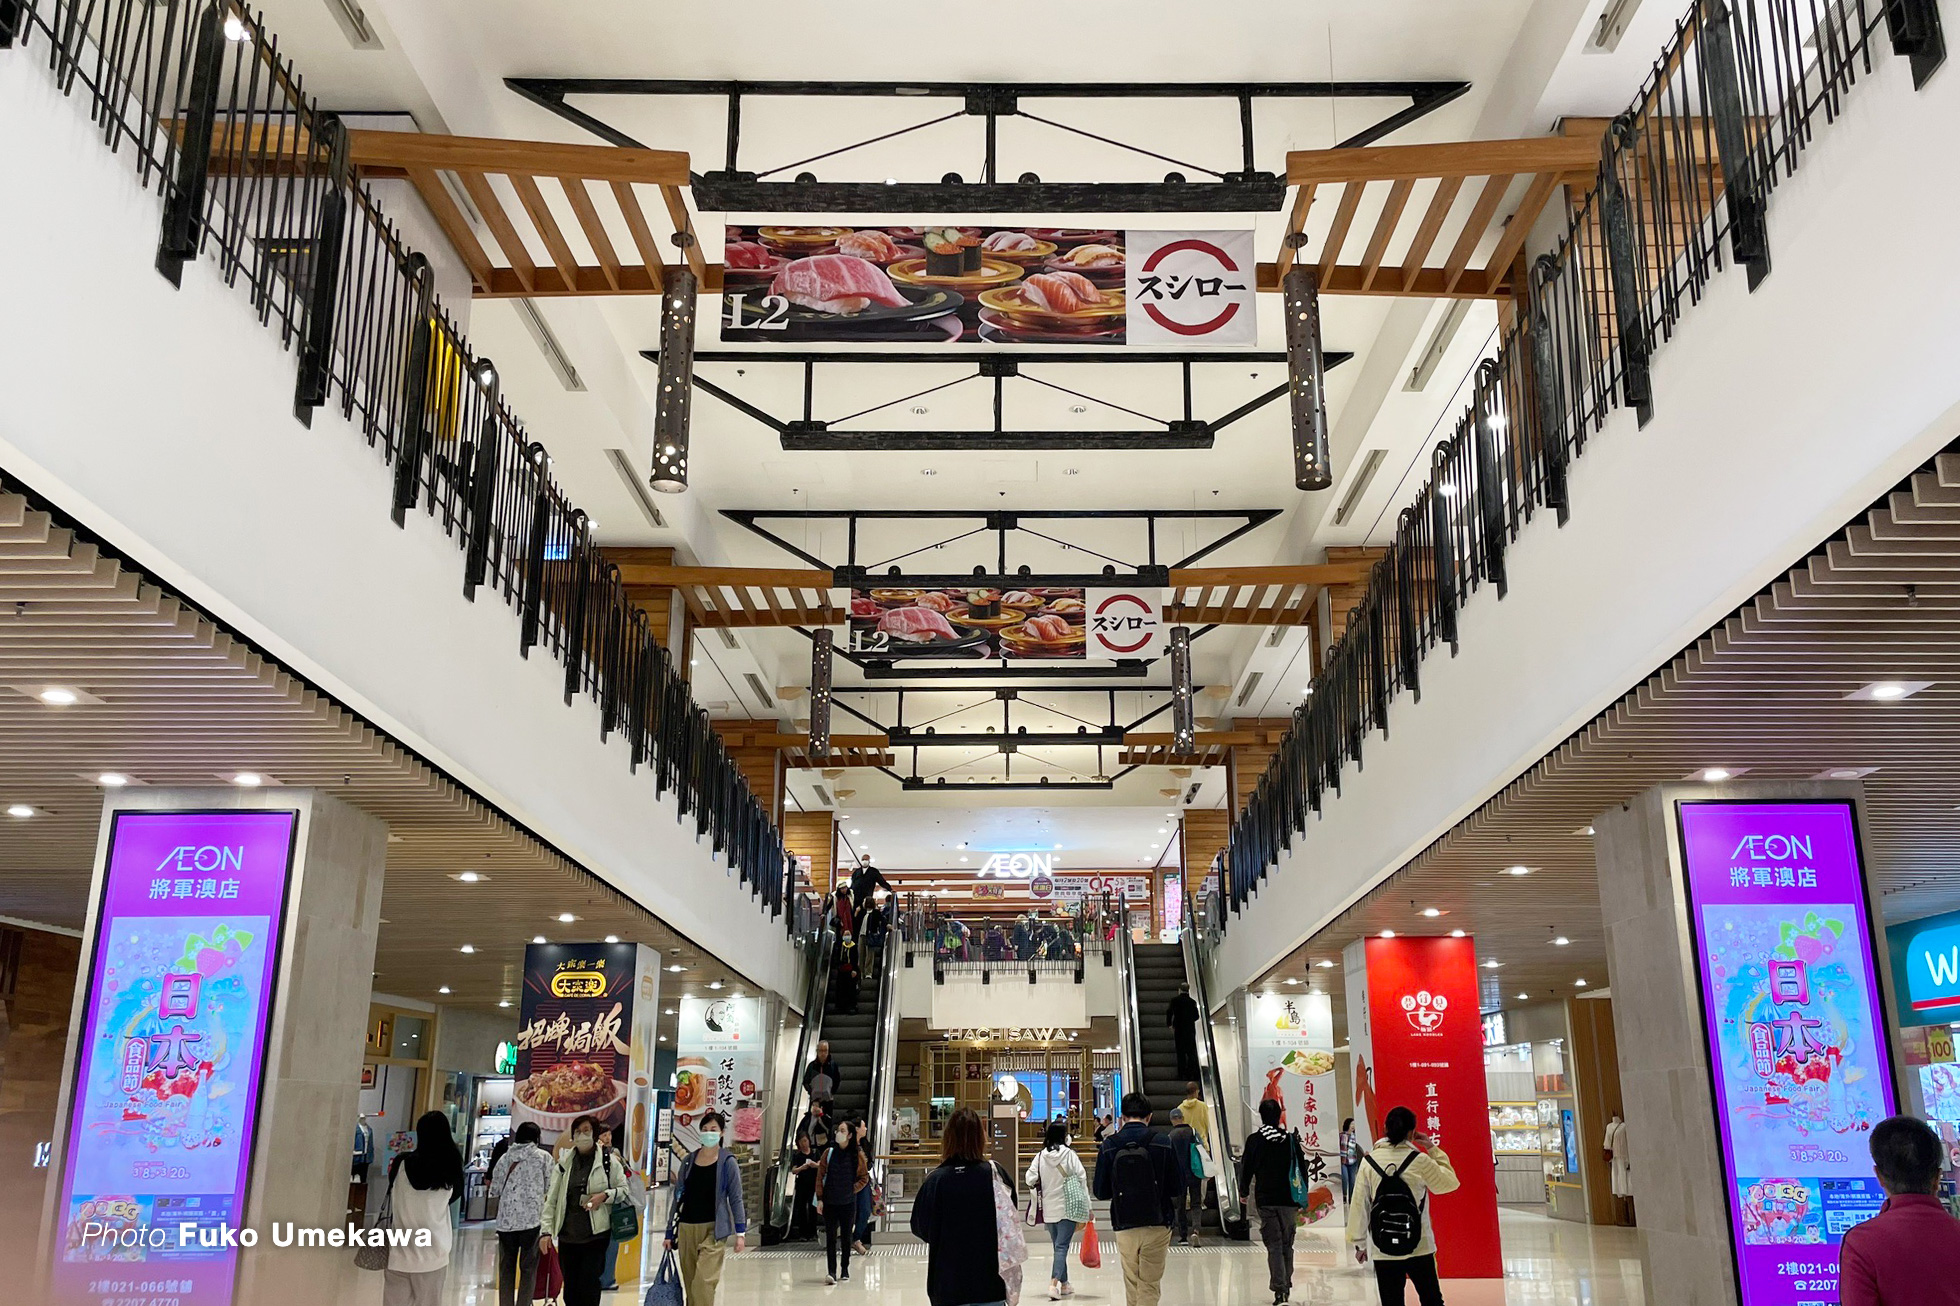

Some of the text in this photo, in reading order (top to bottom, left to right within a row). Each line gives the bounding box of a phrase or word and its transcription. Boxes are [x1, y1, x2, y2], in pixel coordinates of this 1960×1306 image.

[1135, 275, 1247, 300] スシロー
[727, 293, 790, 330] L2
[1091, 615, 1158, 633] スシロー
[853, 631, 890, 653] L2
[1729, 866, 1818, 888] 將軍澳店
[148, 878, 241, 900] 將軍澳店
[1283, 1000, 1301, 1025] 半島
[1769, 959, 1828, 1064] 日本
[146, 972, 203, 1080] 日本
[517, 1002, 631, 1056] 招牌焗飯
[948, 1026, 1068, 1041] HACHISAWA
[1752, 1027, 1772, 1075] 食品節
[1931, 1040, 1951, 1057] 100
[103, 1100, 183, 1108] Japanese Food Fair
[1303, 1079, 1320, 1148] 自家即燒
[1777, 1262, 1840, 1275] 2樓021-0
[1808, 1279, 1838, 1291] 2207
